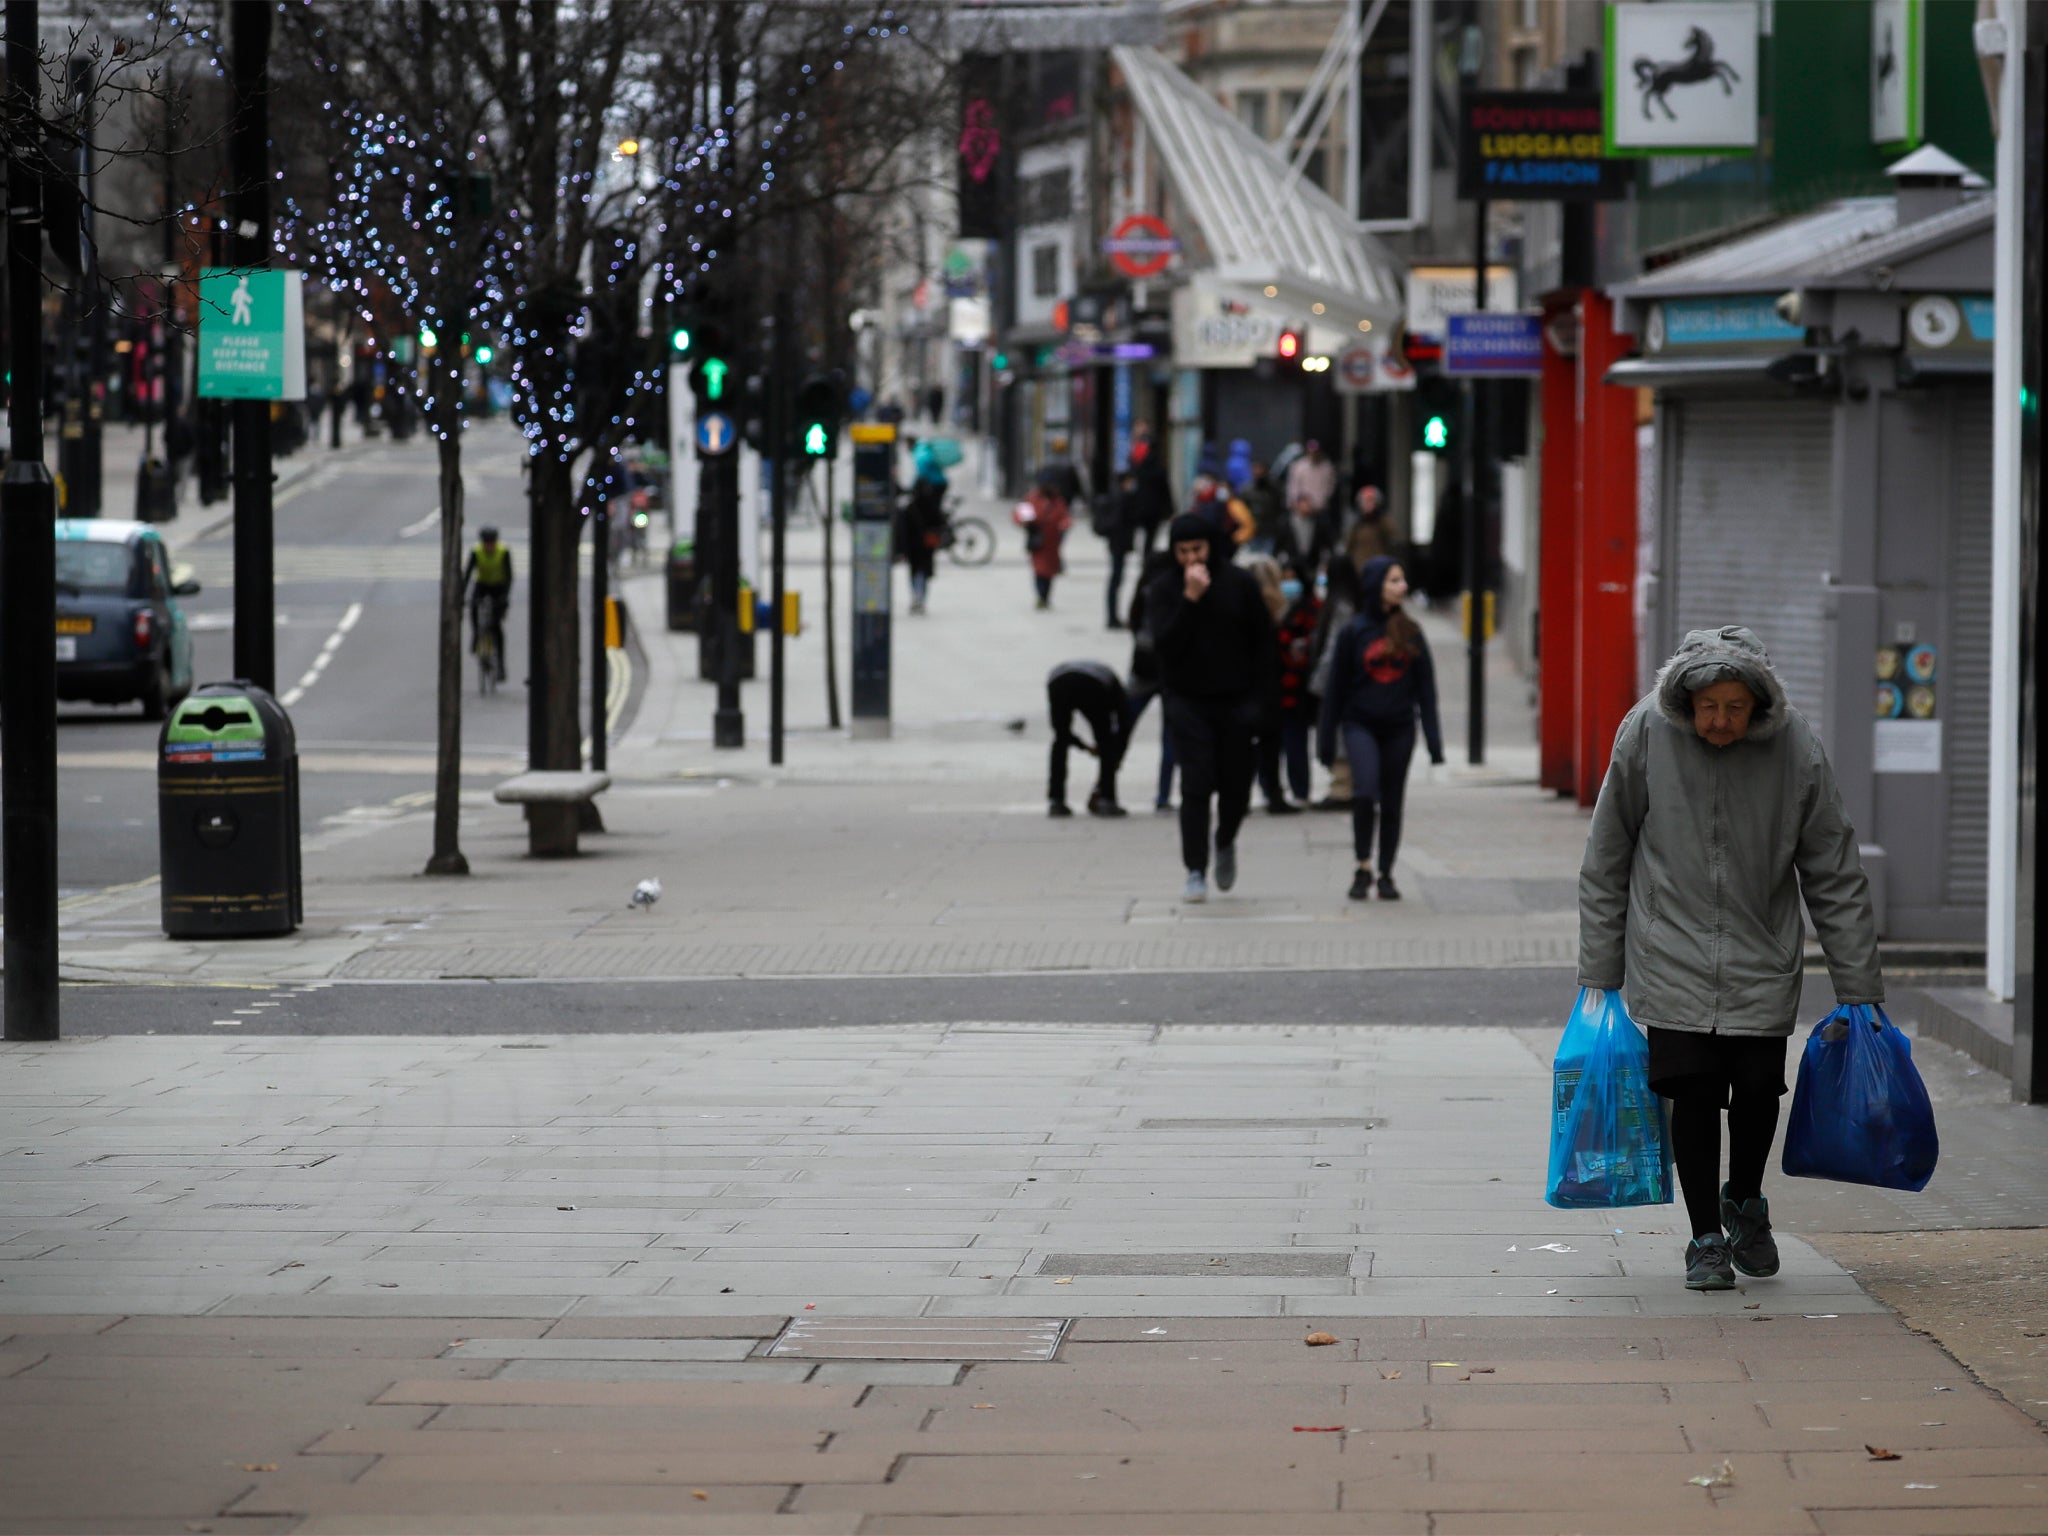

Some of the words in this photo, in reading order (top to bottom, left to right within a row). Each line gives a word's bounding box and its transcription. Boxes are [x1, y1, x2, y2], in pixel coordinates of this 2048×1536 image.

[1480, 134, 1604, 158] LUGGAGE
[1484, 161, 1601, 184] FASHION
[1463, 318, 1528, 334] MONEY
[223, 336, 259, 347] PLEASE
[213, 348, 238, 359] KEEP
[241, 349, 269, 360] YOUR
[215, 360, 266, 372] DISTANCE
